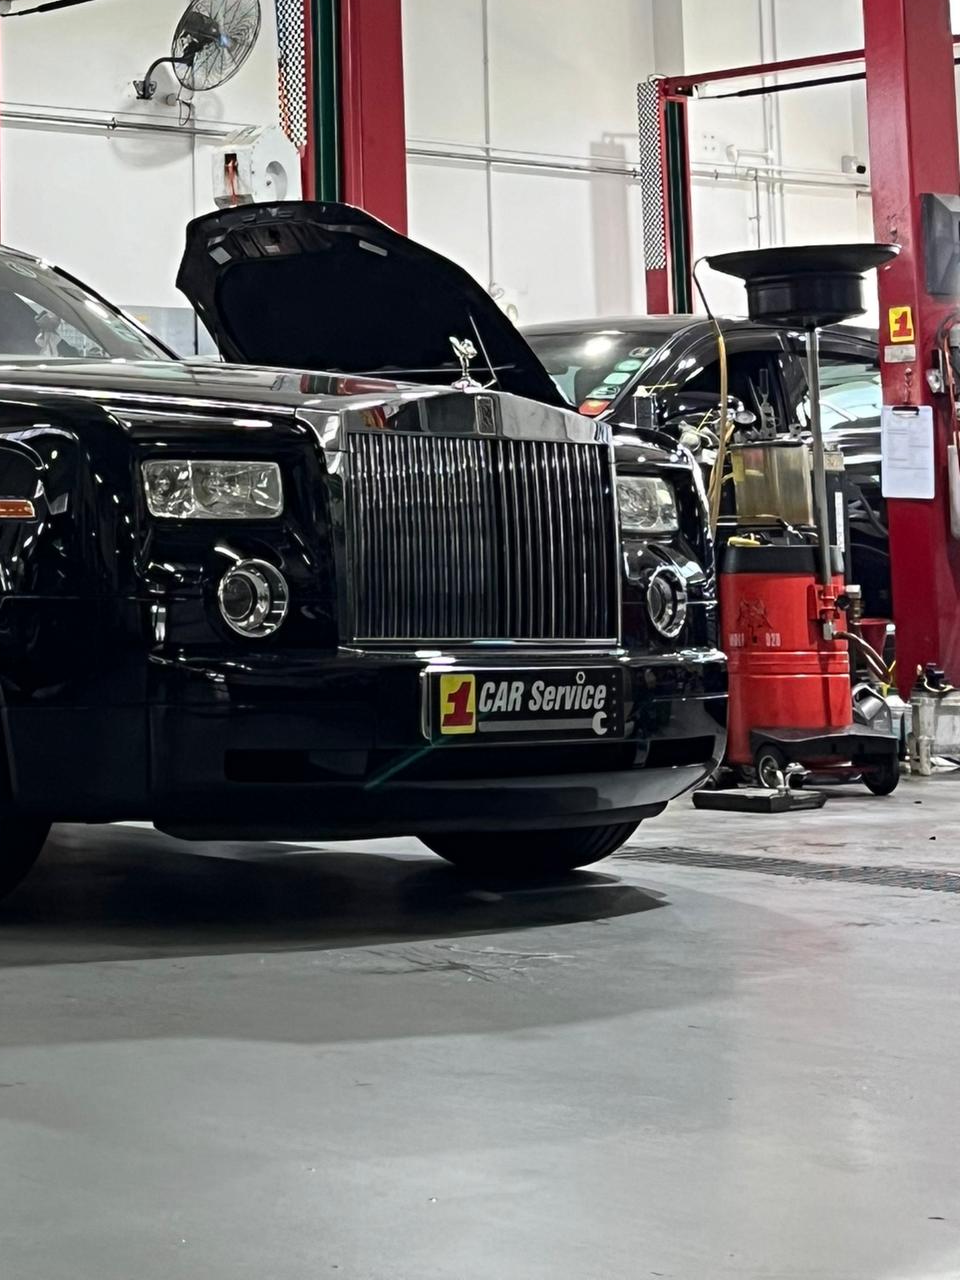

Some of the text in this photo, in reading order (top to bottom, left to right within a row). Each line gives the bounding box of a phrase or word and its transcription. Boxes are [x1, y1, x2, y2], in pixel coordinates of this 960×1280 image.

[892, 310, 913, 338] 1
[442, 674, 607, 727] 1 CAR Service
